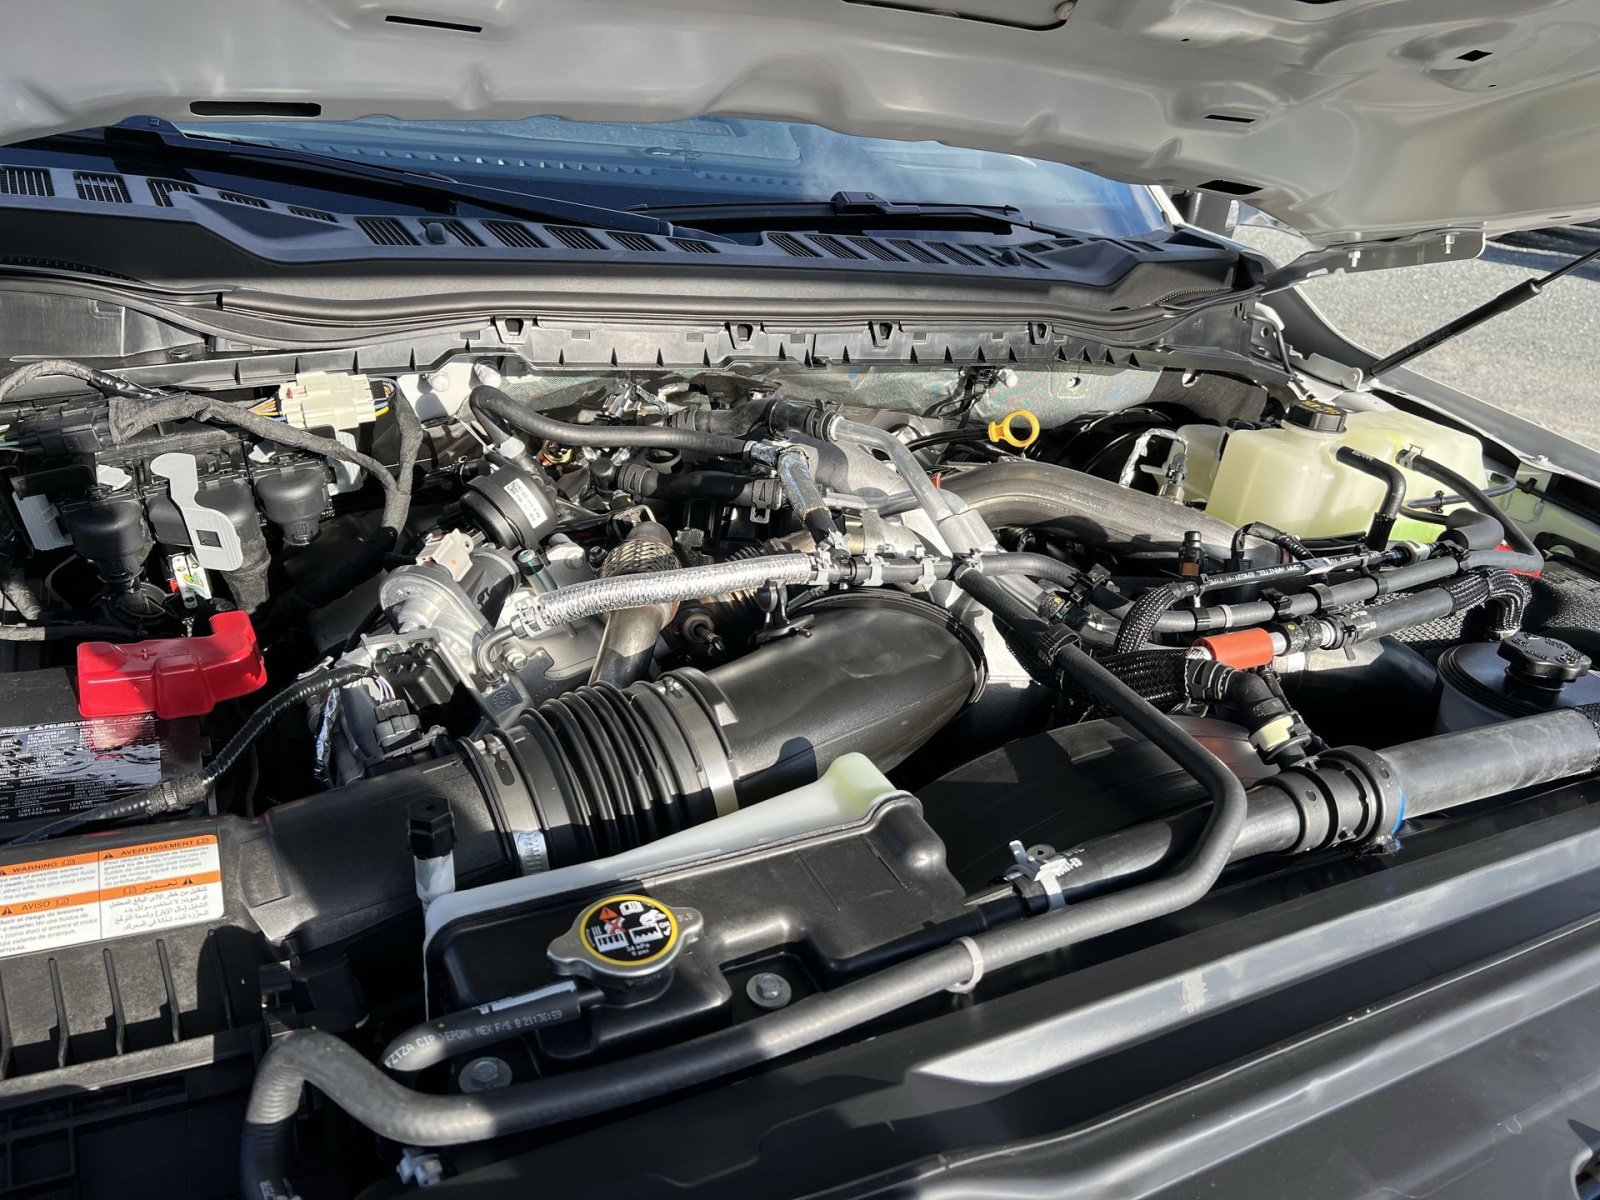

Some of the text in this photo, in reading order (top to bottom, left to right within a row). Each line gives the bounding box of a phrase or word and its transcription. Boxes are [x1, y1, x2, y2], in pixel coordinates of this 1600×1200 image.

[120, 840, 193, 855] AVERTISSEMENT
[12, 861, 56, 873] WARNING
[21, 900, 50, 911] AVISO
[416, 1033, 437, 1049] CIP
[475, 1026, 493, 1036] MEX
[495, 1020, 512, 1033] F/S
